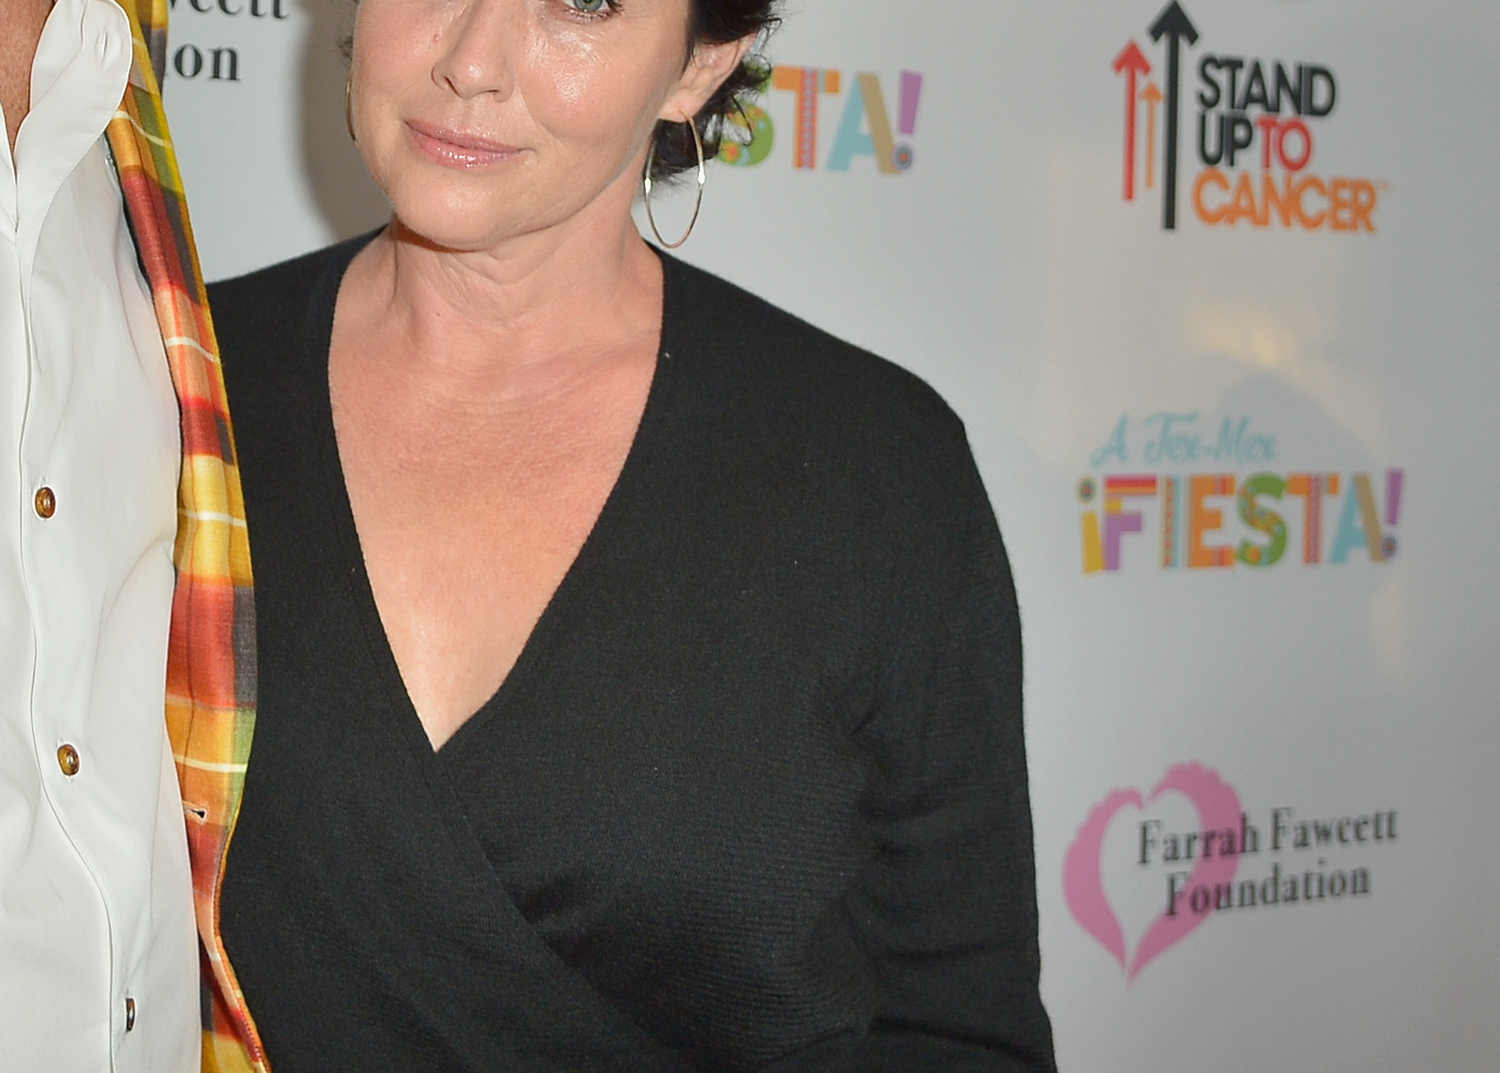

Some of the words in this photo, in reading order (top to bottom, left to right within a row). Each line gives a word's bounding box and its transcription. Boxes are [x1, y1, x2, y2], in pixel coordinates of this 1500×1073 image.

[1197, 56, 1335, 117] STAND
[1199, 112, 1254, 166] UP
[1256, 116, 1313, 171] TO
[1137, 811, 1261, 865] Farrah
[1270, 806, 1398, 852] Fawcett
[1166, 856, 1371, 918] Foundation
